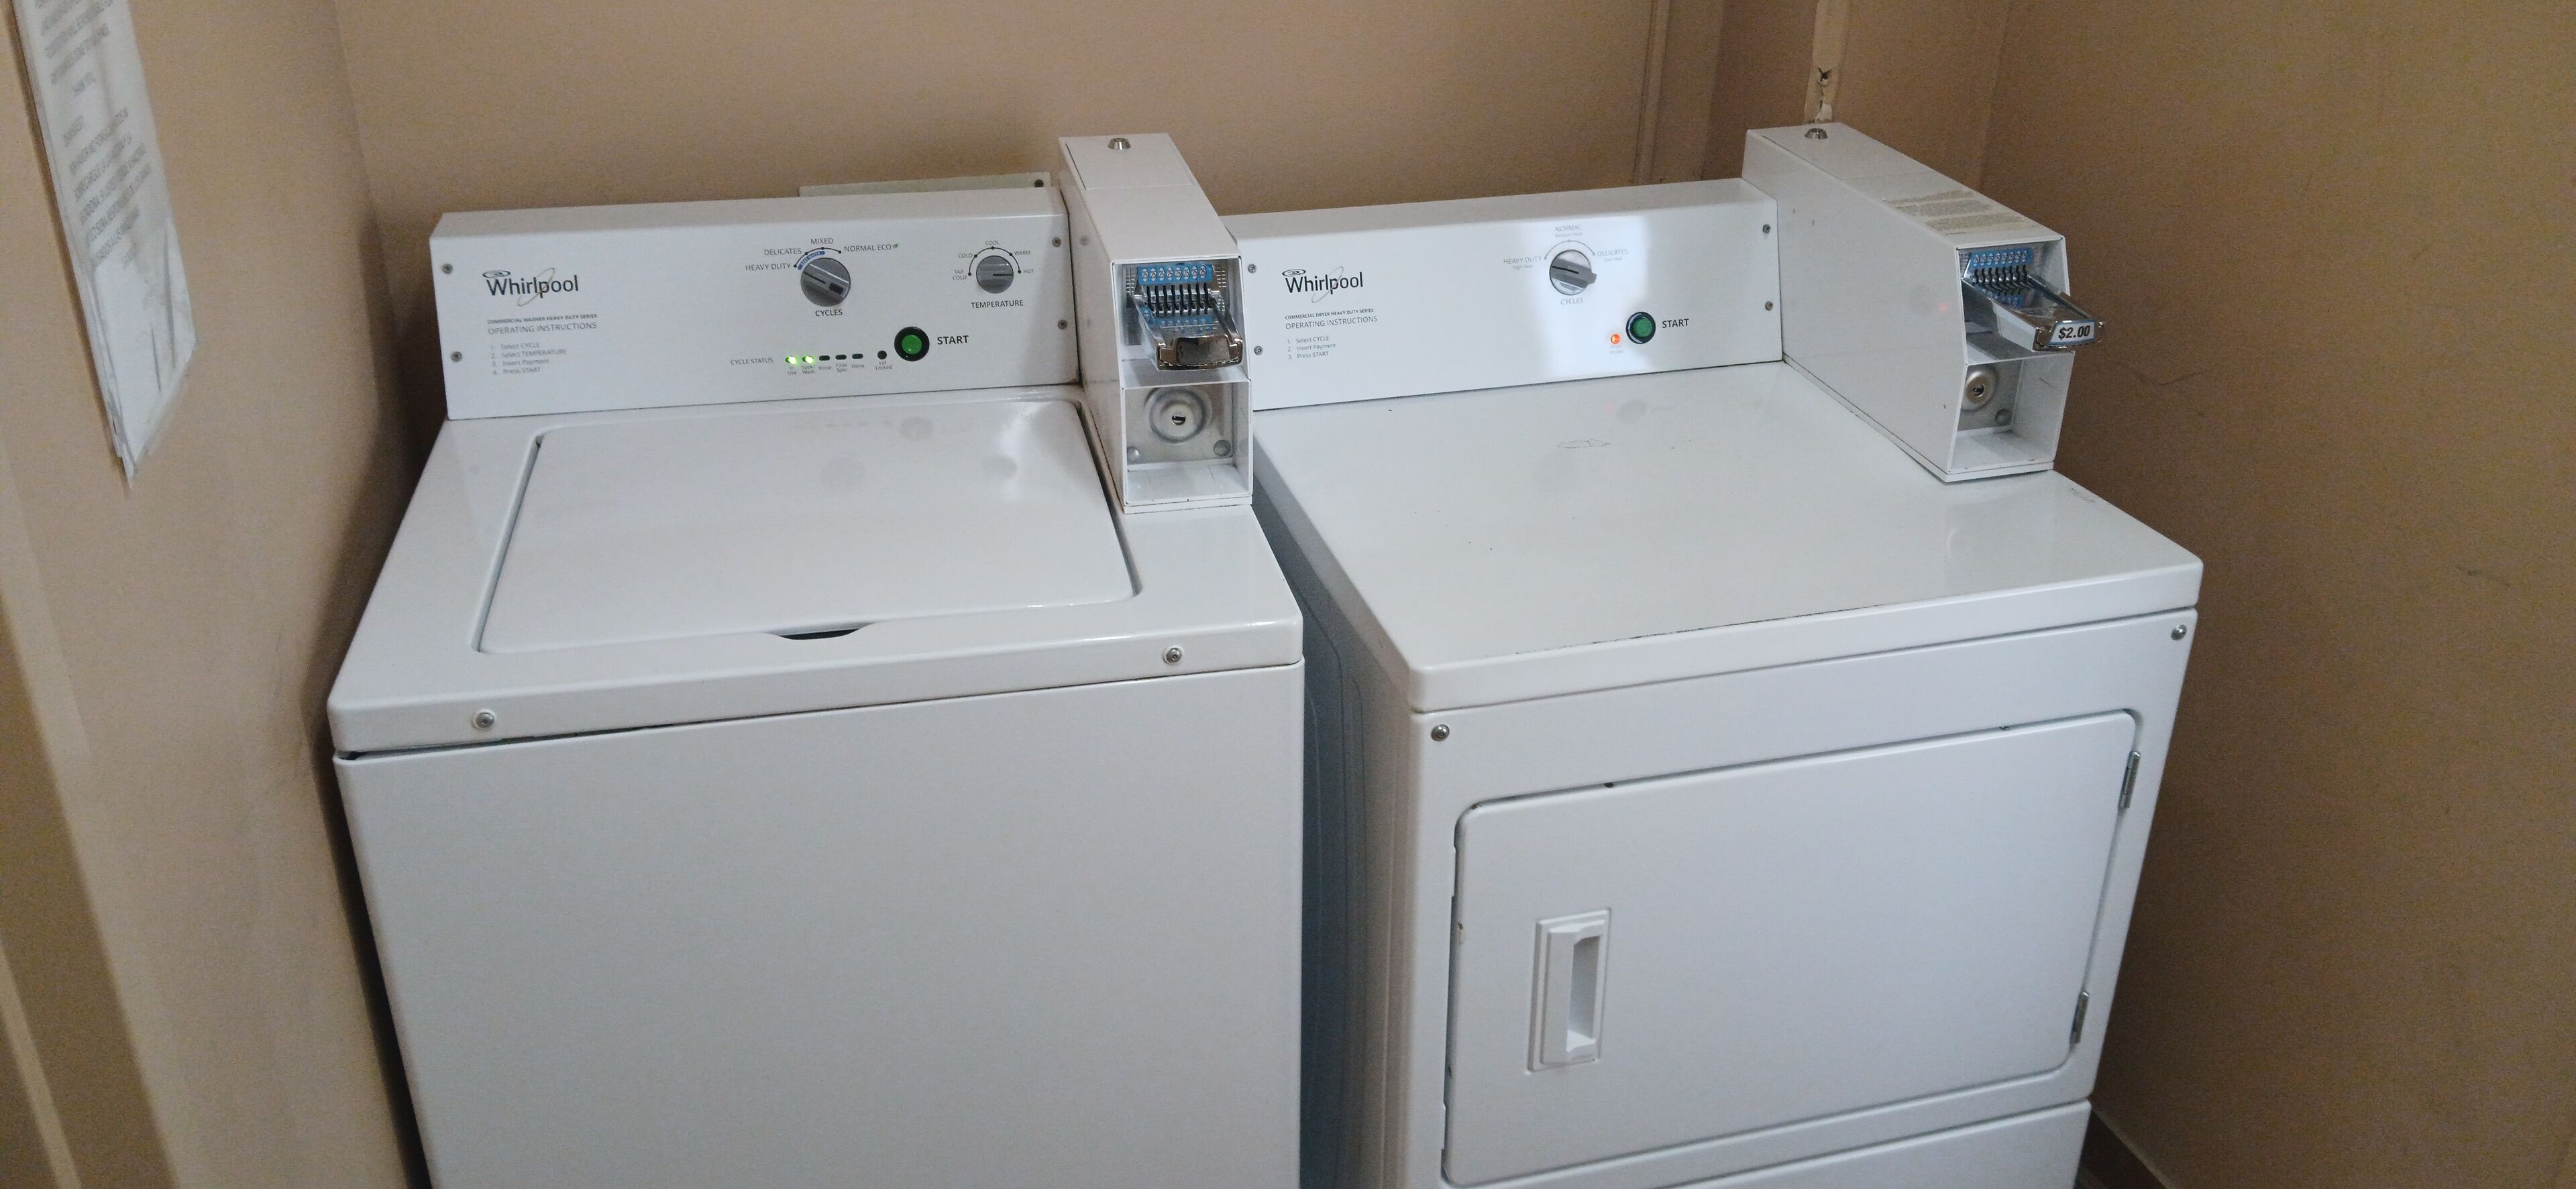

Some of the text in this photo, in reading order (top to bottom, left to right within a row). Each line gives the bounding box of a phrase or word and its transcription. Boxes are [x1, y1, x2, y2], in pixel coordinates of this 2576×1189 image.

[764, 248, 802, 256] DELICATES
[844, 245, 875, 253] NORMAL
[1597, 249, 1629, 257] DELICATES
[745, 264, 770, 272] HEAVY
[486, 274, 579, 298] Whirlpool
[1285, 272, 1363, 294] Whirlpool
[971, 300, 1024, 308] TEMPERATURE
[1560, 297, 1584, 305] CYCLES
[1285, 316, 1378, 329] OPERATING INSTRUCTIONS
[1662, 319, 1689, 328] START
[488, 322, 597, 335] OPERATING INSTRUCTIONS
[2058, 325, 2091, 340] $2.00
[937, 335, 969, 345] START
[1313, 343, 1336, 351] Payment
